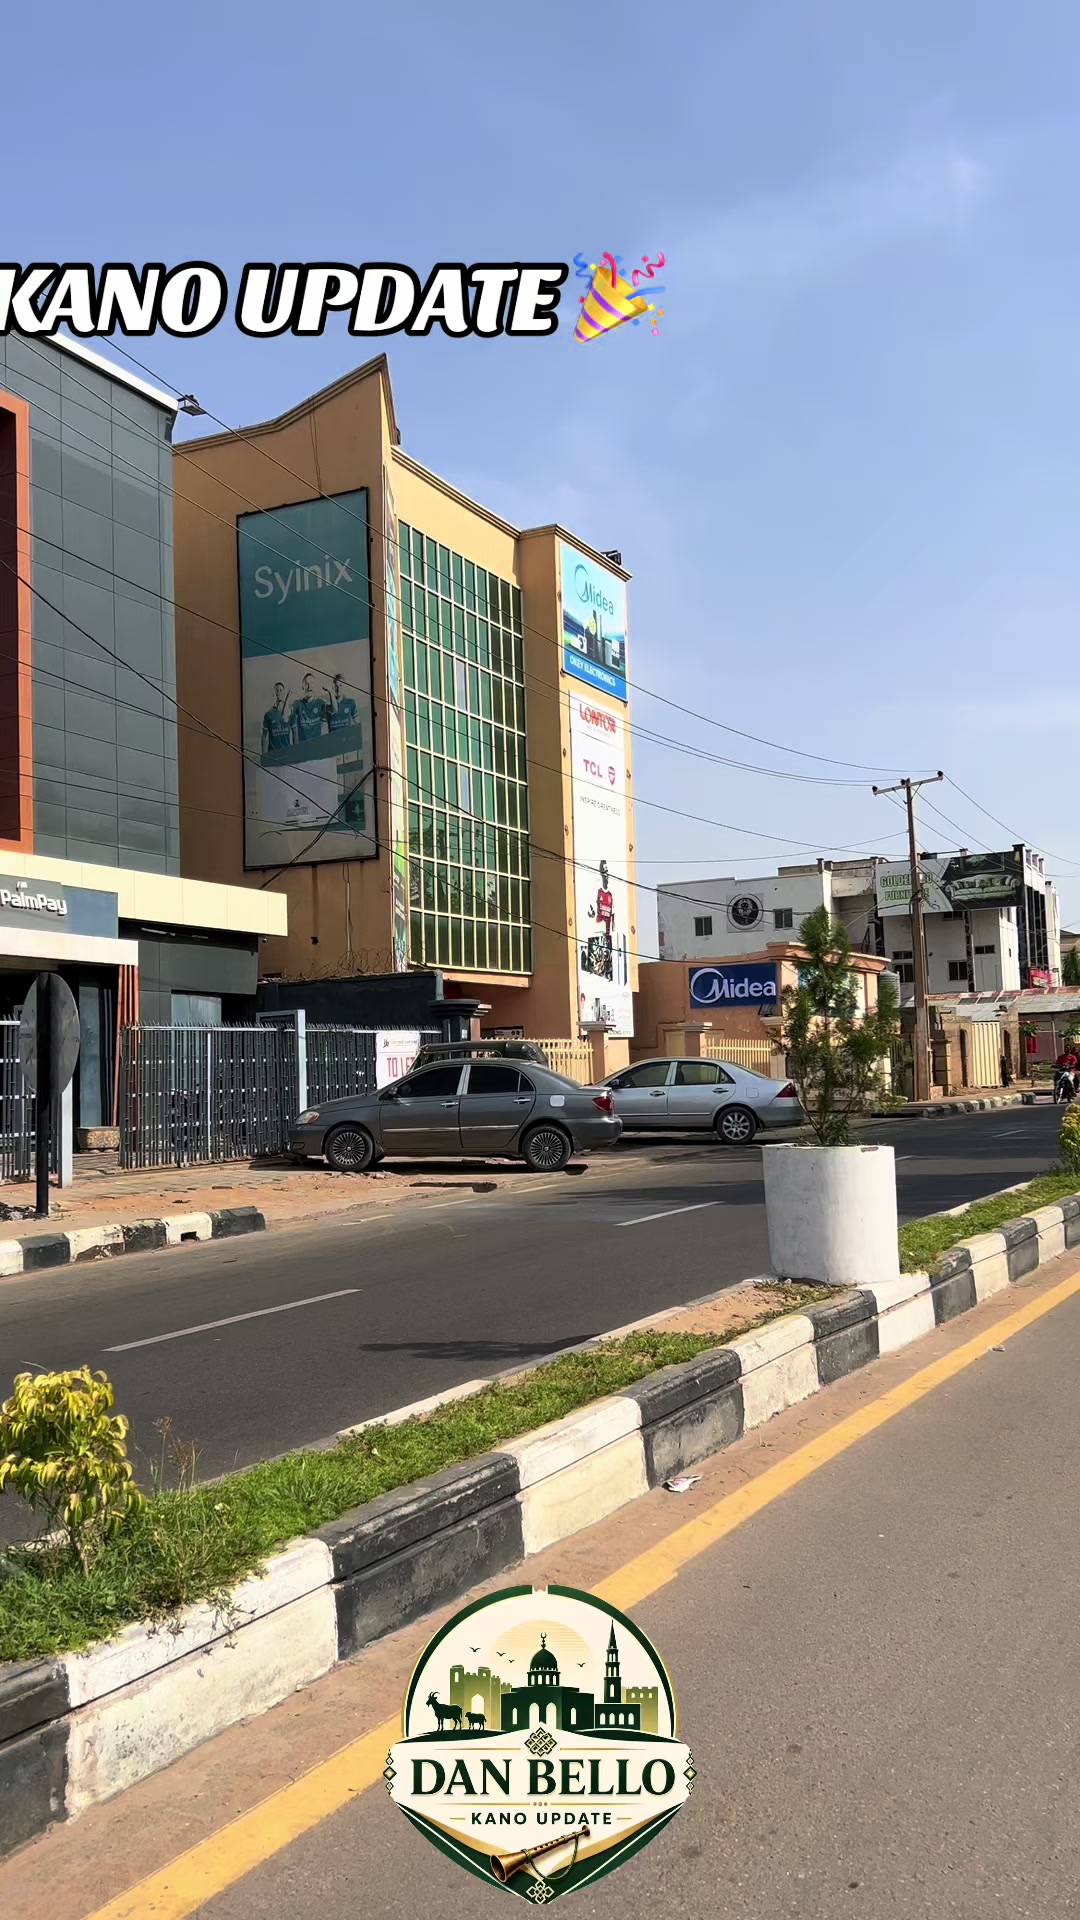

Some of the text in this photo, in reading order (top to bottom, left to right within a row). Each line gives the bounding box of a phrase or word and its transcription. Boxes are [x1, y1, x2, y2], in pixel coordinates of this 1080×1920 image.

[254, 554, 353, 605] Syinix
[574, 563, 615, 616] Midea
[584, 661, 616, 687] ELECTRONICS
[580, 703, 616, 734] LONTOR
[583, 758, 603, 778] TCL
[0, 889, 68, 915] PalmPay
[690, 967, 777, 1004] Midea
[387, 1057, 398, 1078] TO
